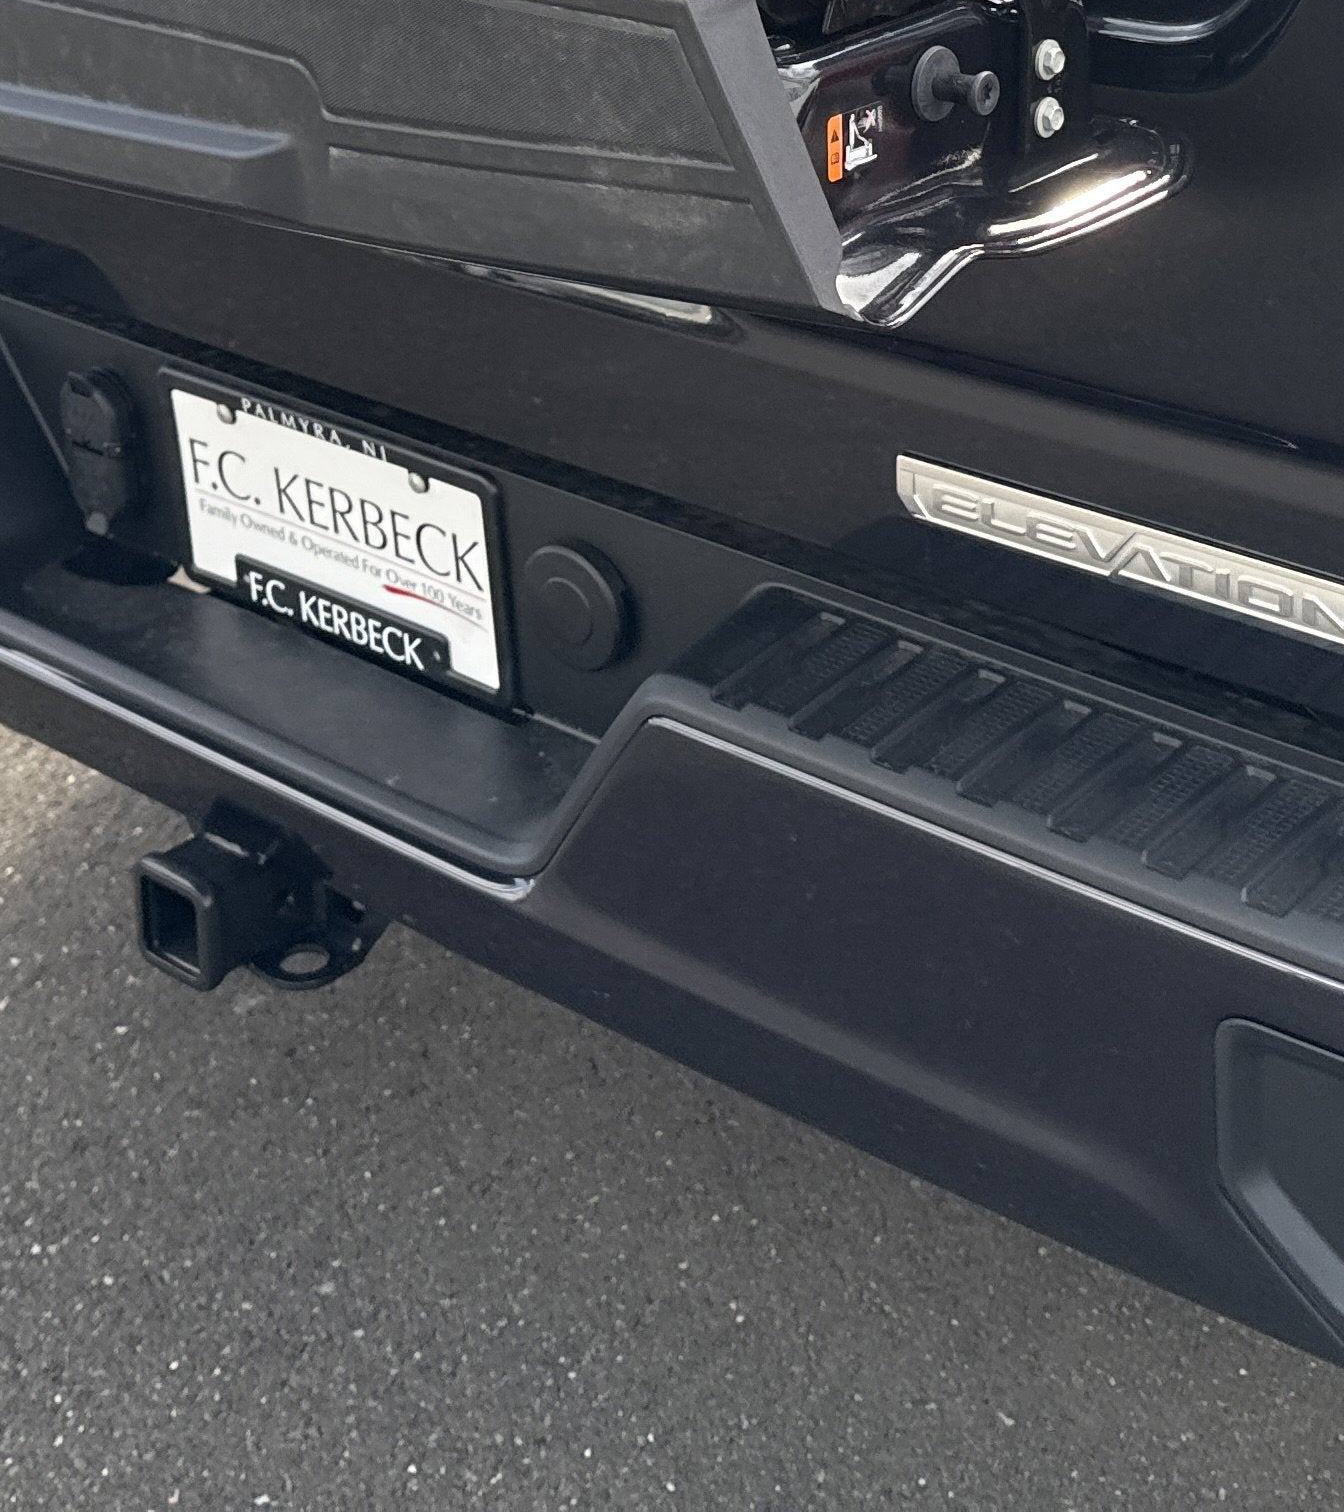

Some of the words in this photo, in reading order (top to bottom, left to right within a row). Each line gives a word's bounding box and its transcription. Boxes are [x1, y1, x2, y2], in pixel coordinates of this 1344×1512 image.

[187, 436, 262, 506] F.C.
[273, 465, 485, 592] KERBECK
[199, 497, 237, 528] Family
[240, 512, 286, 543] Owned
[288, 529, 299, 548] &
[300, 534, 360, 571] Operated
[361, 558, 384, 580] For
[385, 567, 420, 591] Over
[422, 580, 446, 605] 100
[447, 591, 484, 621] Years
[247, 570, 294, 617] F.C.
[298, 590, 425, 671] KERBECK
